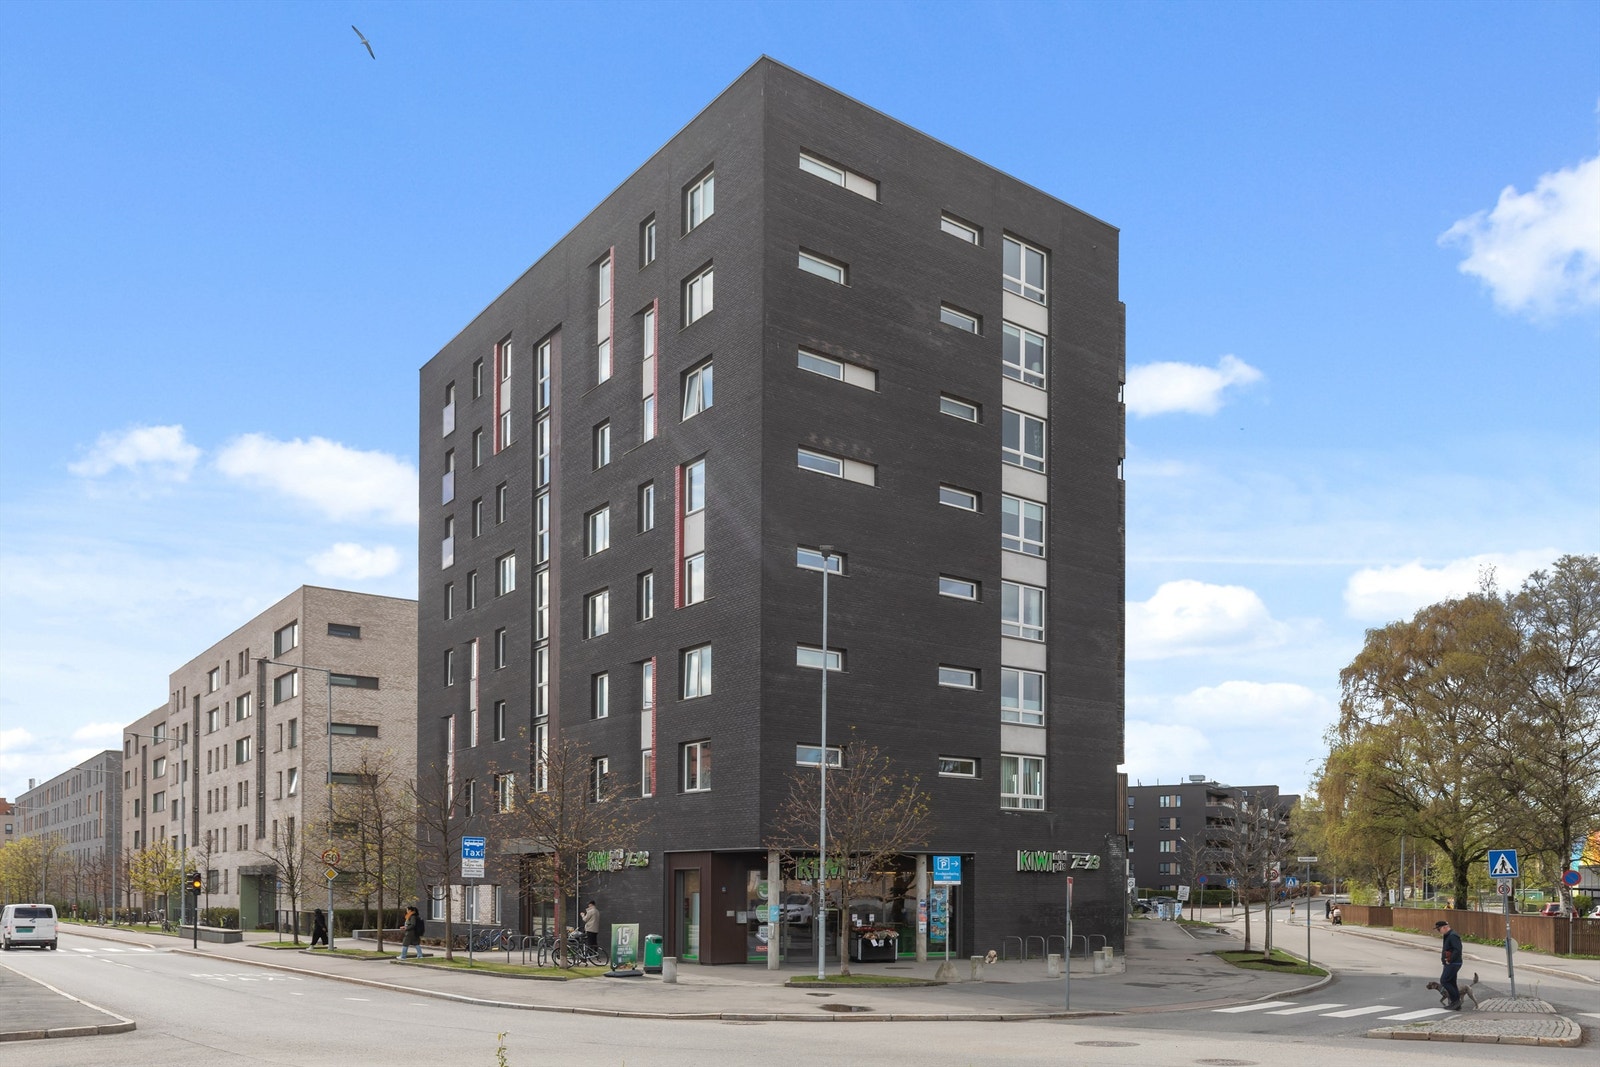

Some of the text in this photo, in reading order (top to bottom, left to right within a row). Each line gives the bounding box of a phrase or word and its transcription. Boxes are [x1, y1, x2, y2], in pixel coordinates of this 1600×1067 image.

[464, 848, 483, 857] Taxi
[325, 853, 337, 862] 50
[1017, 850, 1053, 872] KIWI
